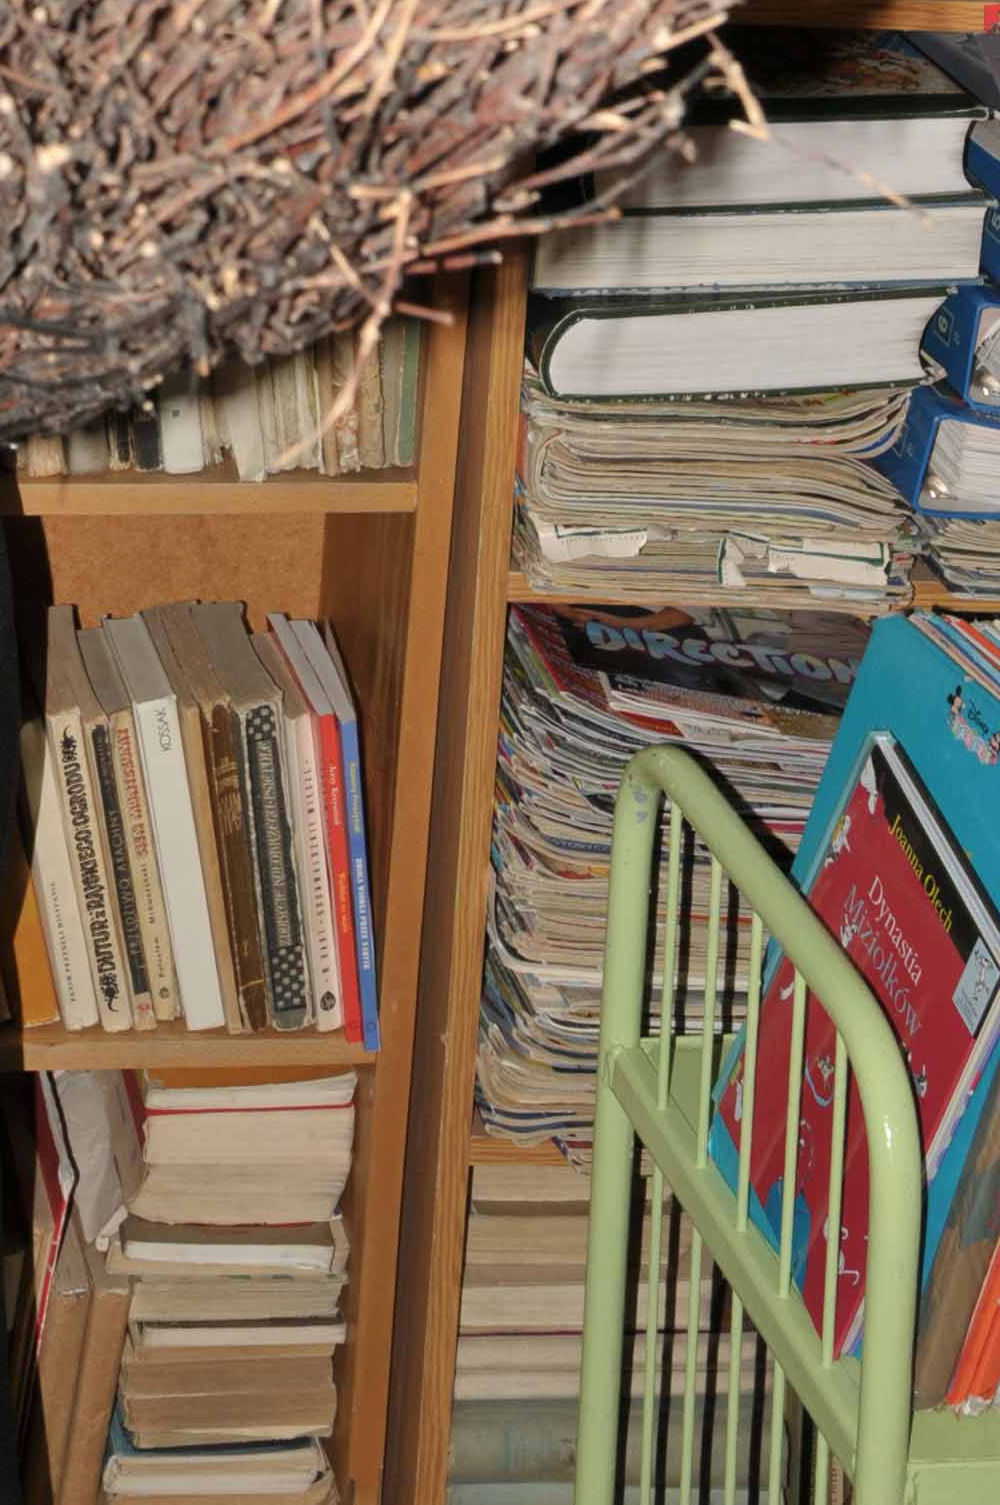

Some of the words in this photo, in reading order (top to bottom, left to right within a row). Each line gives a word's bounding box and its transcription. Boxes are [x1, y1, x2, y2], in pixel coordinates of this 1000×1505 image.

[154, 708, 172, 752] KOSSAK
[63, 763, 89, 825] OGRODU
[327, 764, 338, 785] Jerzy
[74, 830, 107, 910] RAJSKIEGO
[888, 813, 926, 881] Joanna
[920, 872, 954, 934] Olech
[90, 919, 117, 974] DUTUR
[844, 885, 922, 1038] Miziołków
[867, 876, 923, 985] Dynastia
